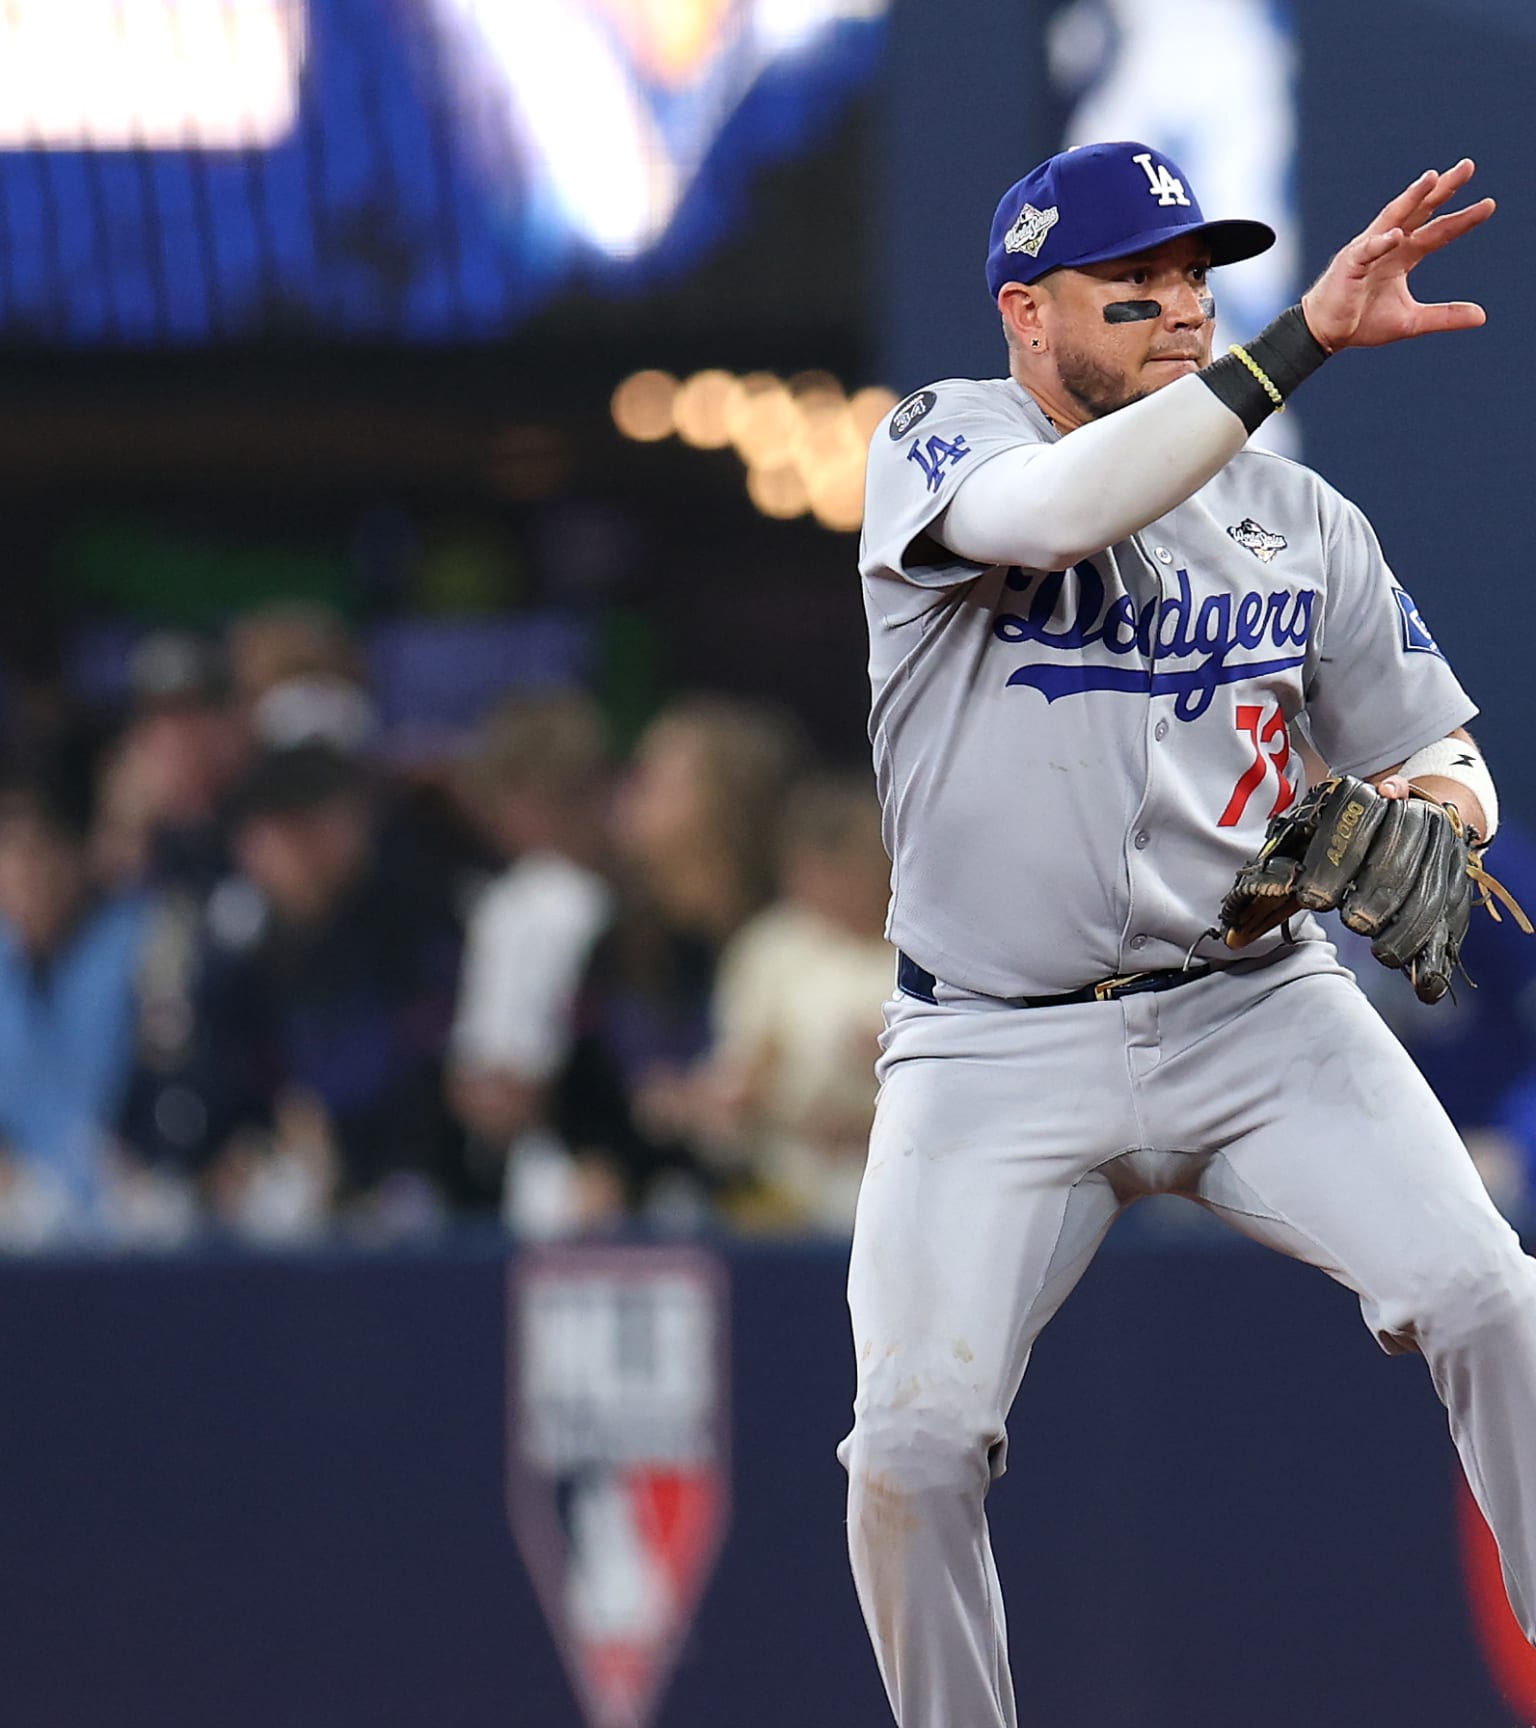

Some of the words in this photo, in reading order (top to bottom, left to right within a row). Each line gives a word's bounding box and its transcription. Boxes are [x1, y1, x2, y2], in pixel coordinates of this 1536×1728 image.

[1132, 153, 1191, 206] LA
[906, 434, 970, 493] LA
[993, 561, 1315, 722] Dodgers
[1216, 705, 1297, 827] 72
[1327, 801, 1365, 867] A2000
